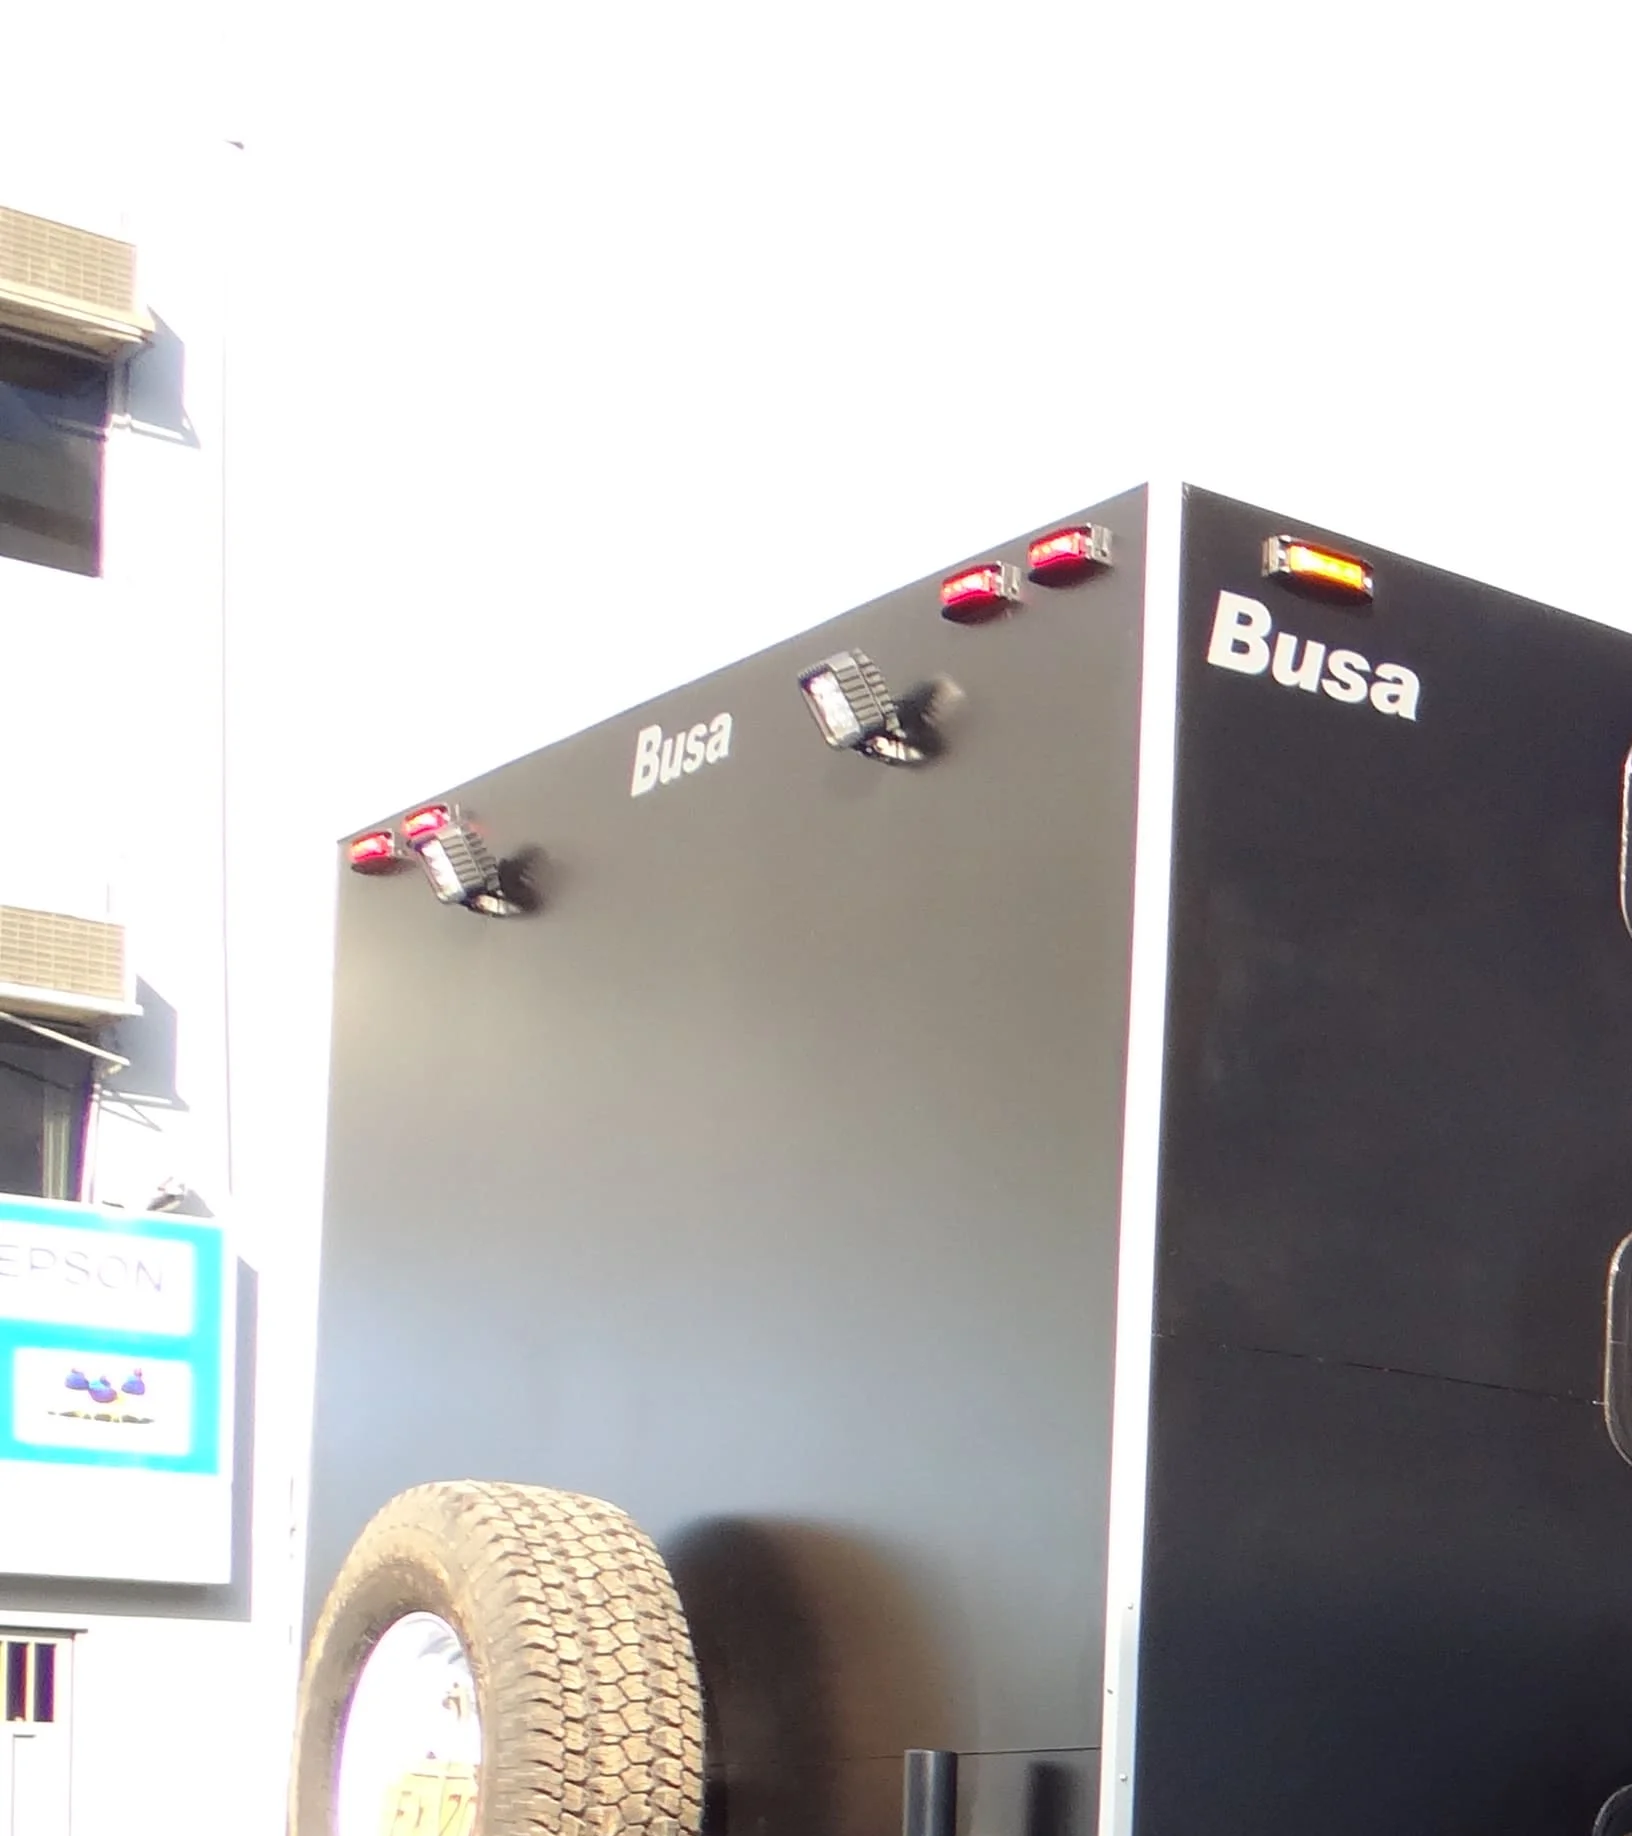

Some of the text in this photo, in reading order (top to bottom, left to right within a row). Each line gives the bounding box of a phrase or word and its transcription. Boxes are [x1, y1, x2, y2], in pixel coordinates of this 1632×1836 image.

[1207, 589, 1420, 721] Busa
[630, 711, 733, 798] Busa
[0, 1243, 164, 1293] EPSON
